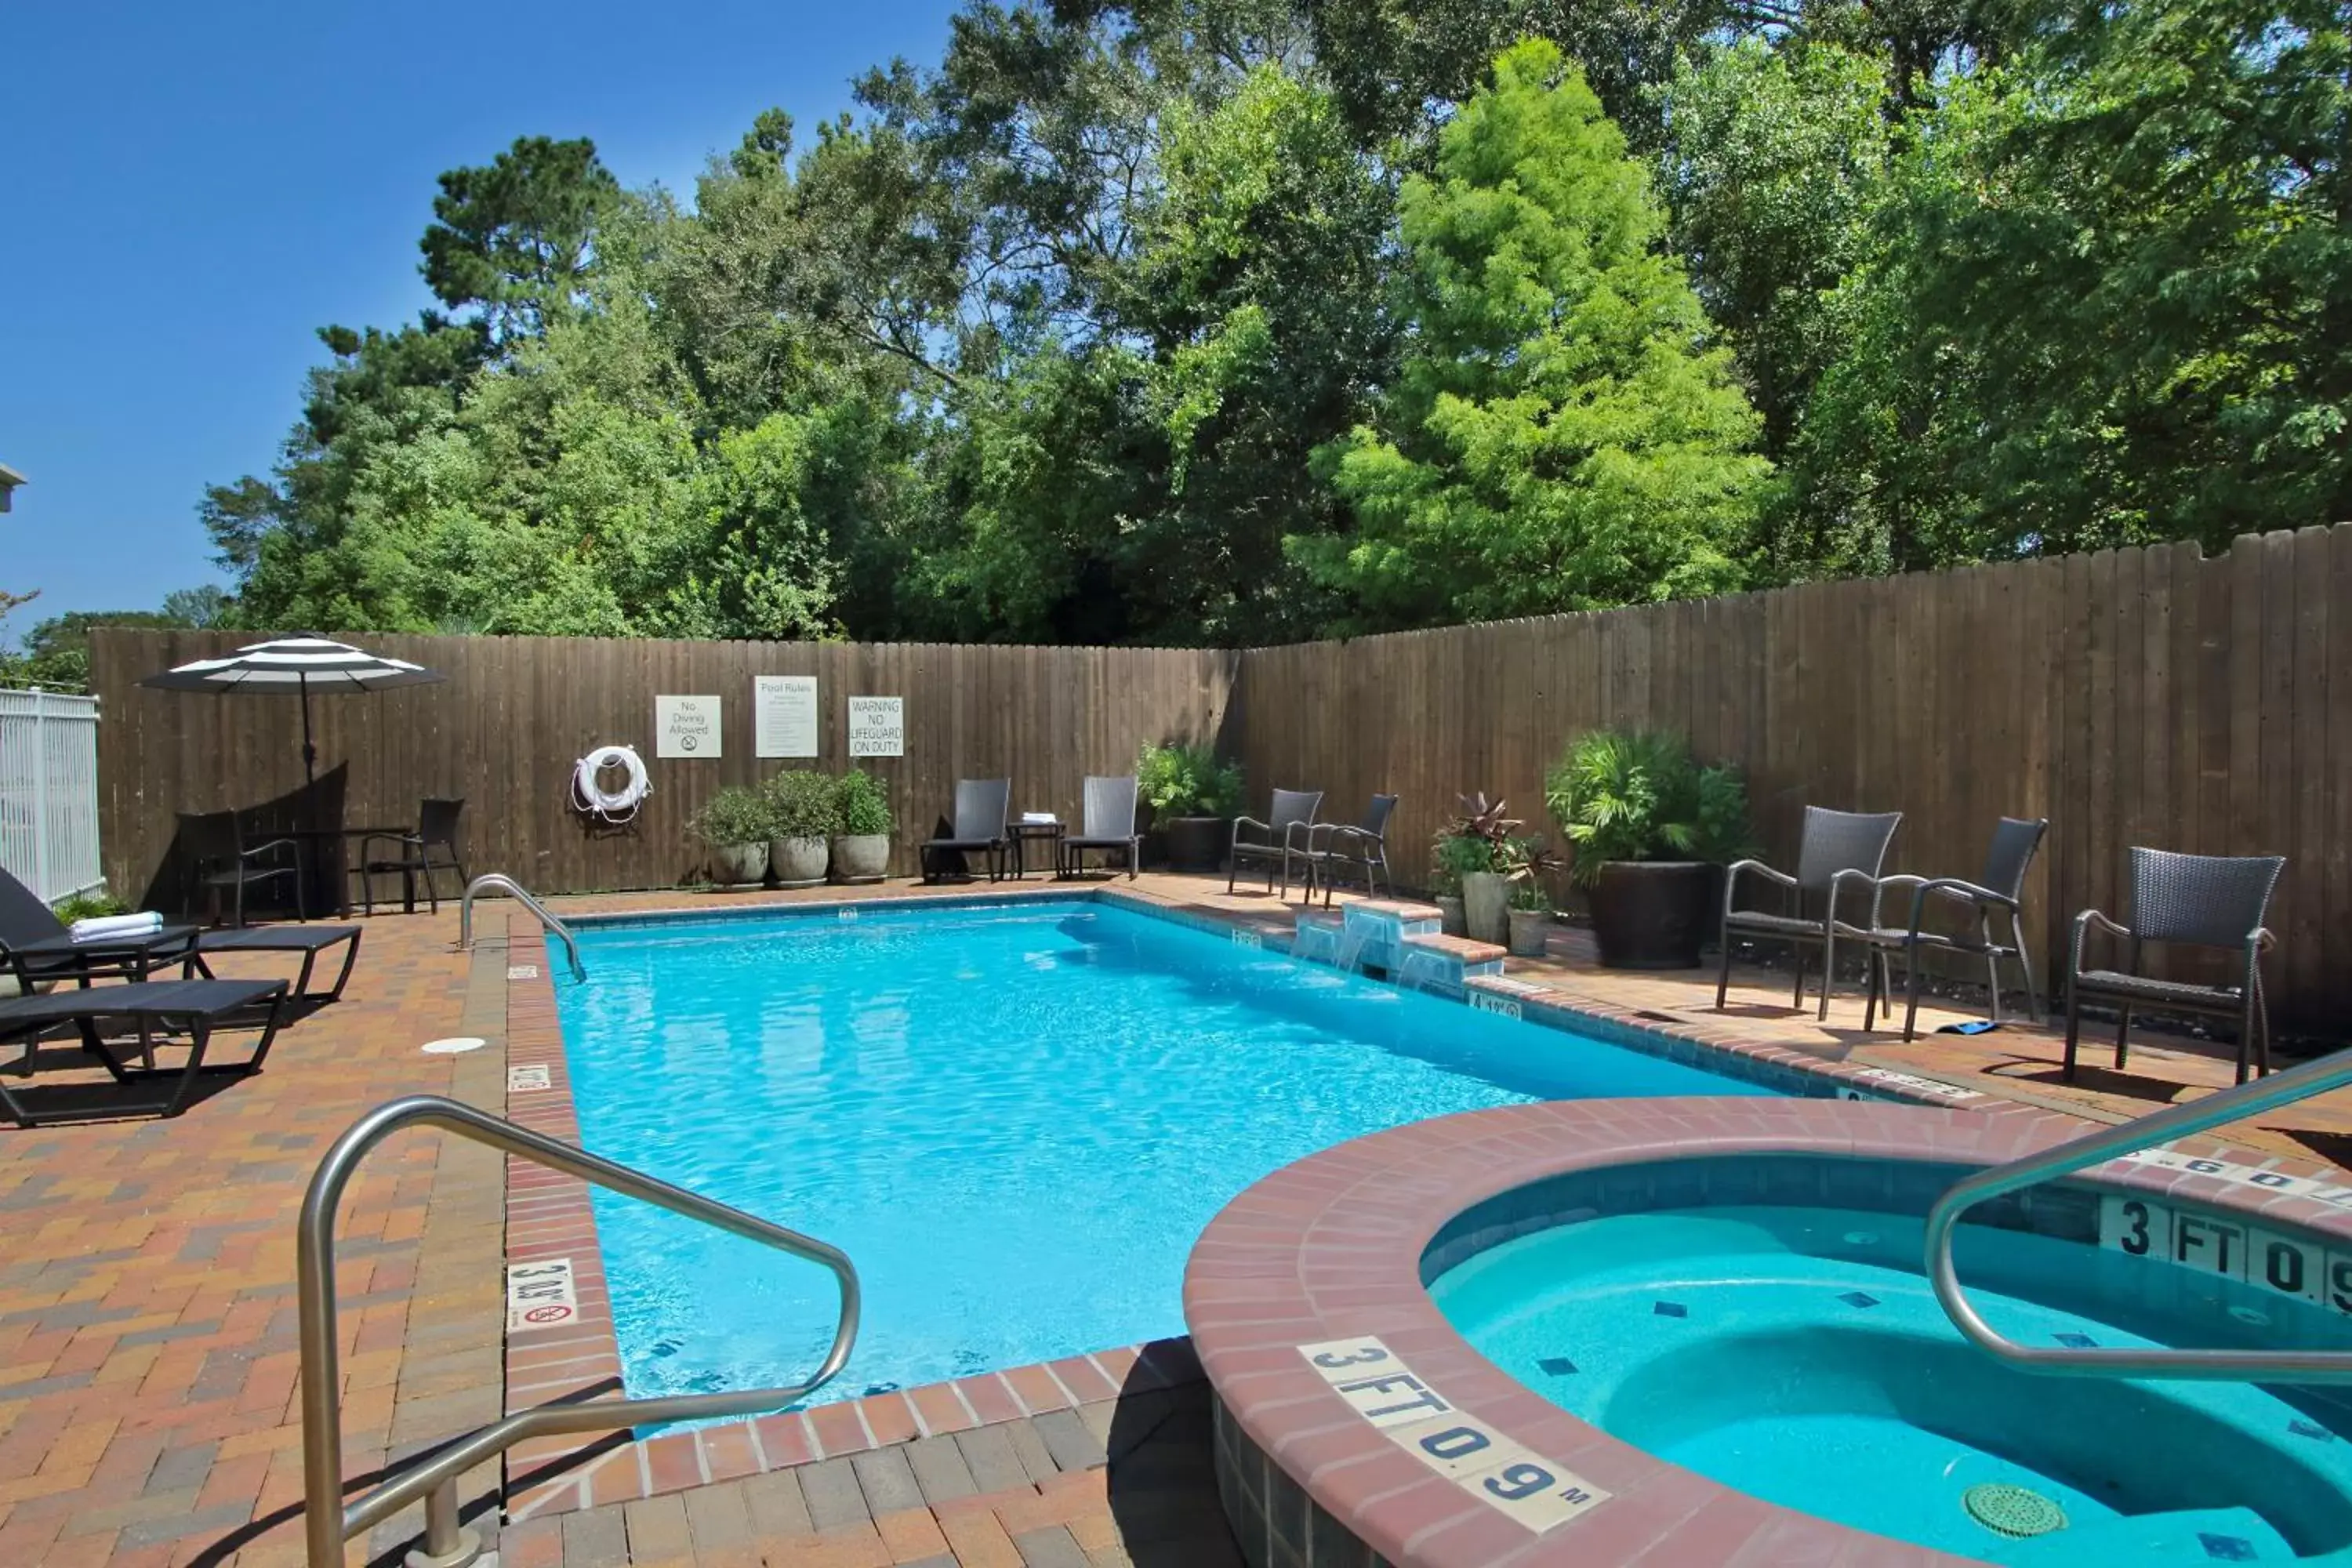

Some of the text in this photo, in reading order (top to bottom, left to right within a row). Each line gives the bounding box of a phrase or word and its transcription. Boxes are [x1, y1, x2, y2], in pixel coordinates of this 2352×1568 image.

[760, 683, 782, 691] Pool
[681, 702, 696, 710] No
[853, 701, 899, 712] WARNING
[673, 713, 705, 724] Diving
[868, 714, 884, 725] NO
[670, 724, 708, 735] Allowed
[851, 727, 902, 739] LIFEGUARD
[855, 741, 899, 752] ON DUTY
[2121, 1201, 2149, 1255] 3
[2178, 1217, 2240, 1274] FT
[1313, 1347, 1388, 1369] 3
[1339, 1374, 1450, 1418] FT
